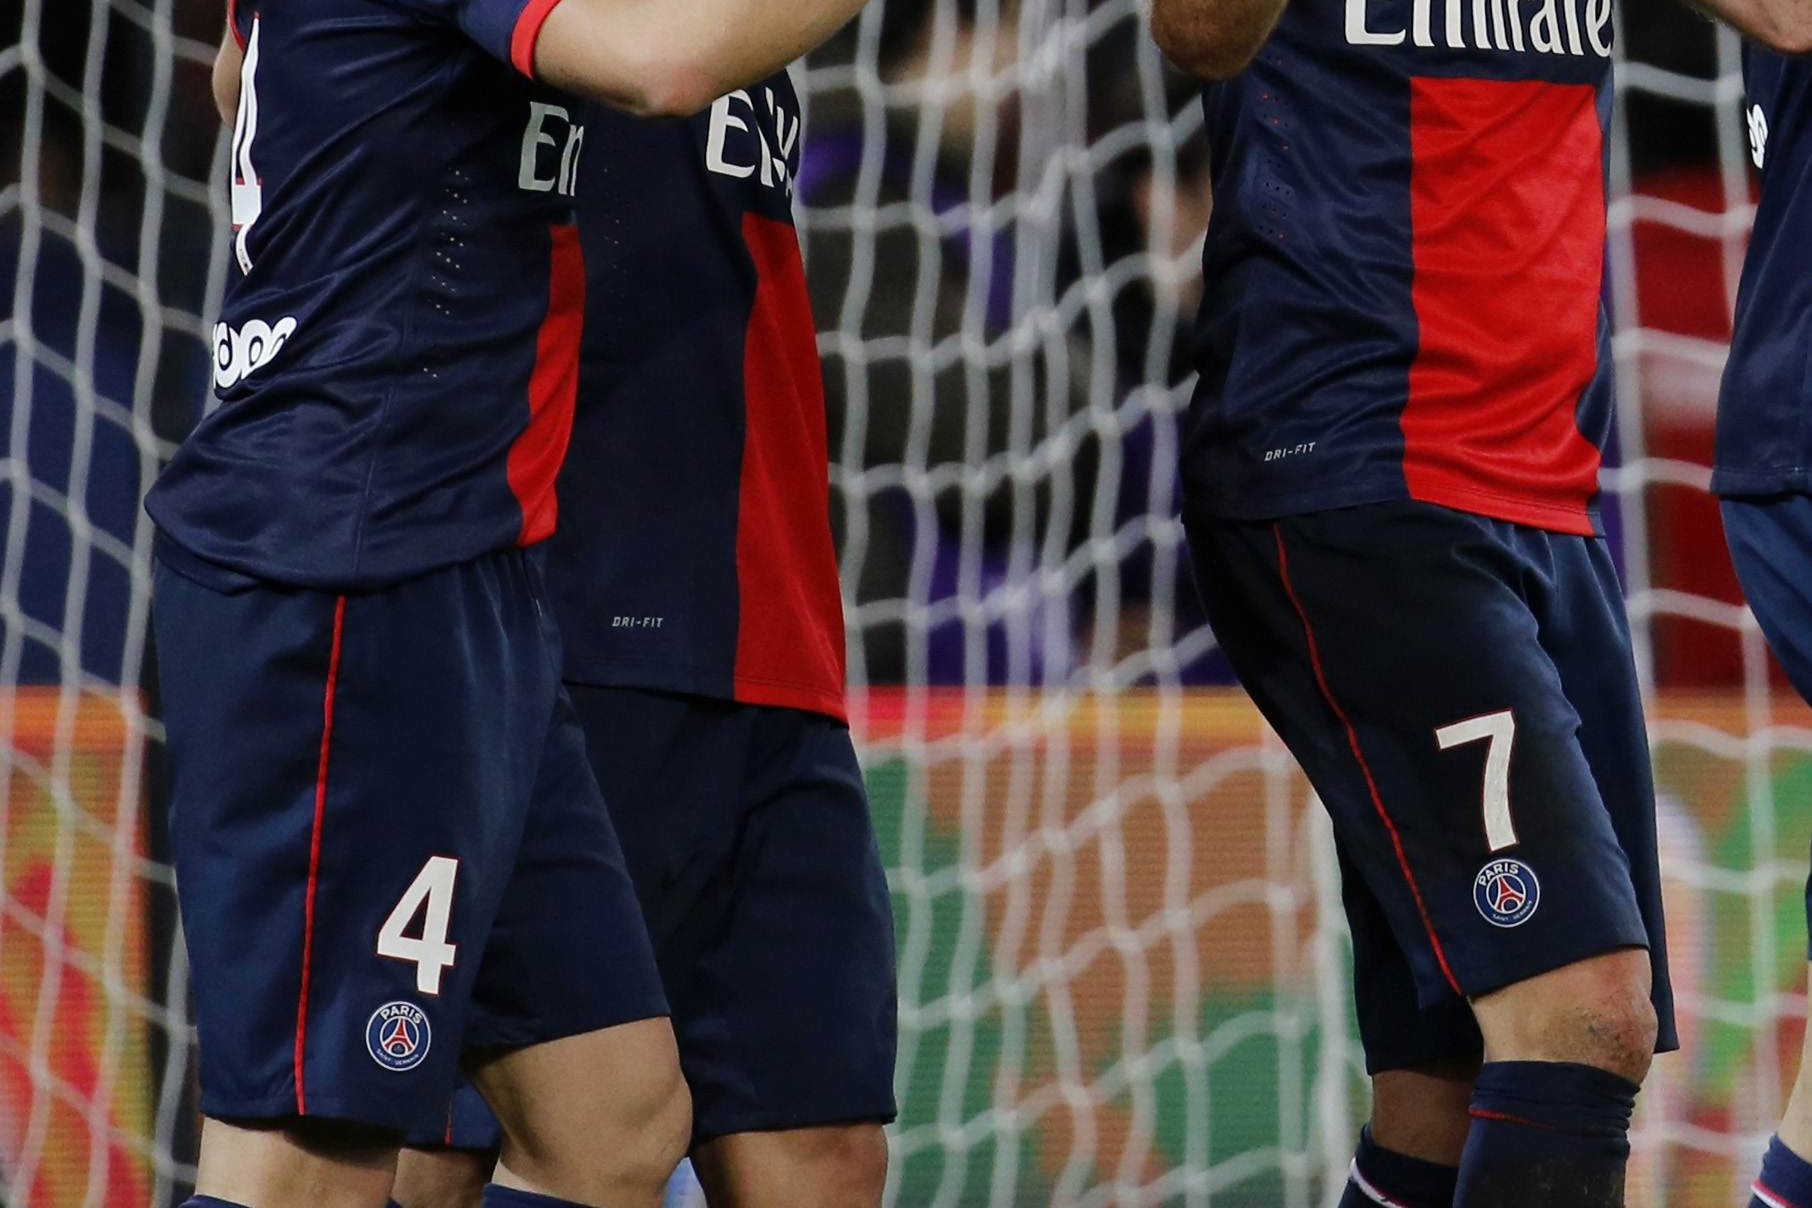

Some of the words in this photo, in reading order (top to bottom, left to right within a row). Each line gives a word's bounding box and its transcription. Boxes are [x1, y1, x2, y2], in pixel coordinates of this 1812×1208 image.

[1263, 441, 1316, 462] DRI-FIT
[611, 615, 664, 628] DRI-FIT
[1434, 708, 1519, 853] 7
[1478, 862, 1519, 887] PARIS
[376, 853, 460, 996] 4
[379, 1005, 422, 1025] PARIS
